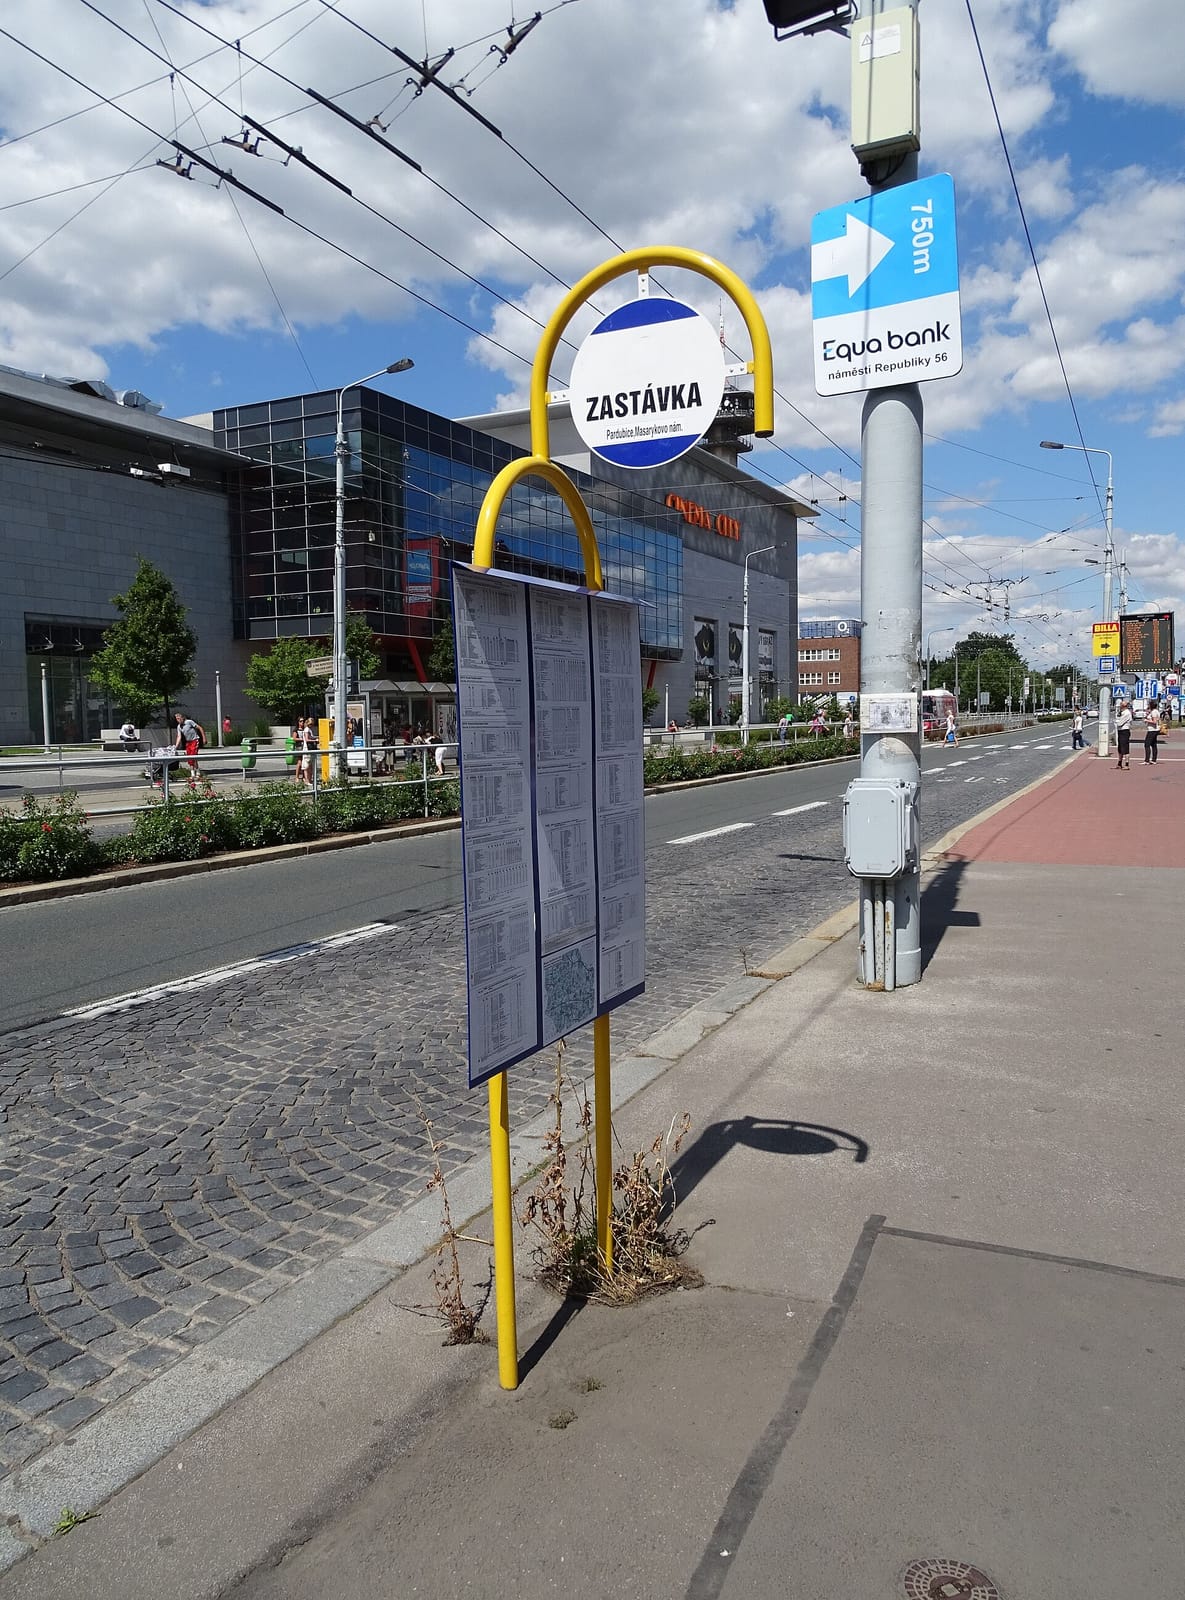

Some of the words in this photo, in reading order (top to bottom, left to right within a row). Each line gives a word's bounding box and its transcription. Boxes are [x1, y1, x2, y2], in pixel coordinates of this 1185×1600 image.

[911, 199, 934, 274] 750m
[823, 337, 882, 362] Equa
[887, 321, 951, 350] bank
[828, 365, 872, 380] náměstí
[874, 355, 931, 374] Republiky
[934, 352, 948, 363] 56
[586, 382, 702, 422] ZASTÁVKA
[669, 421, 683, 432] nám.
[1094, 624, 1118, 632] BILLA
